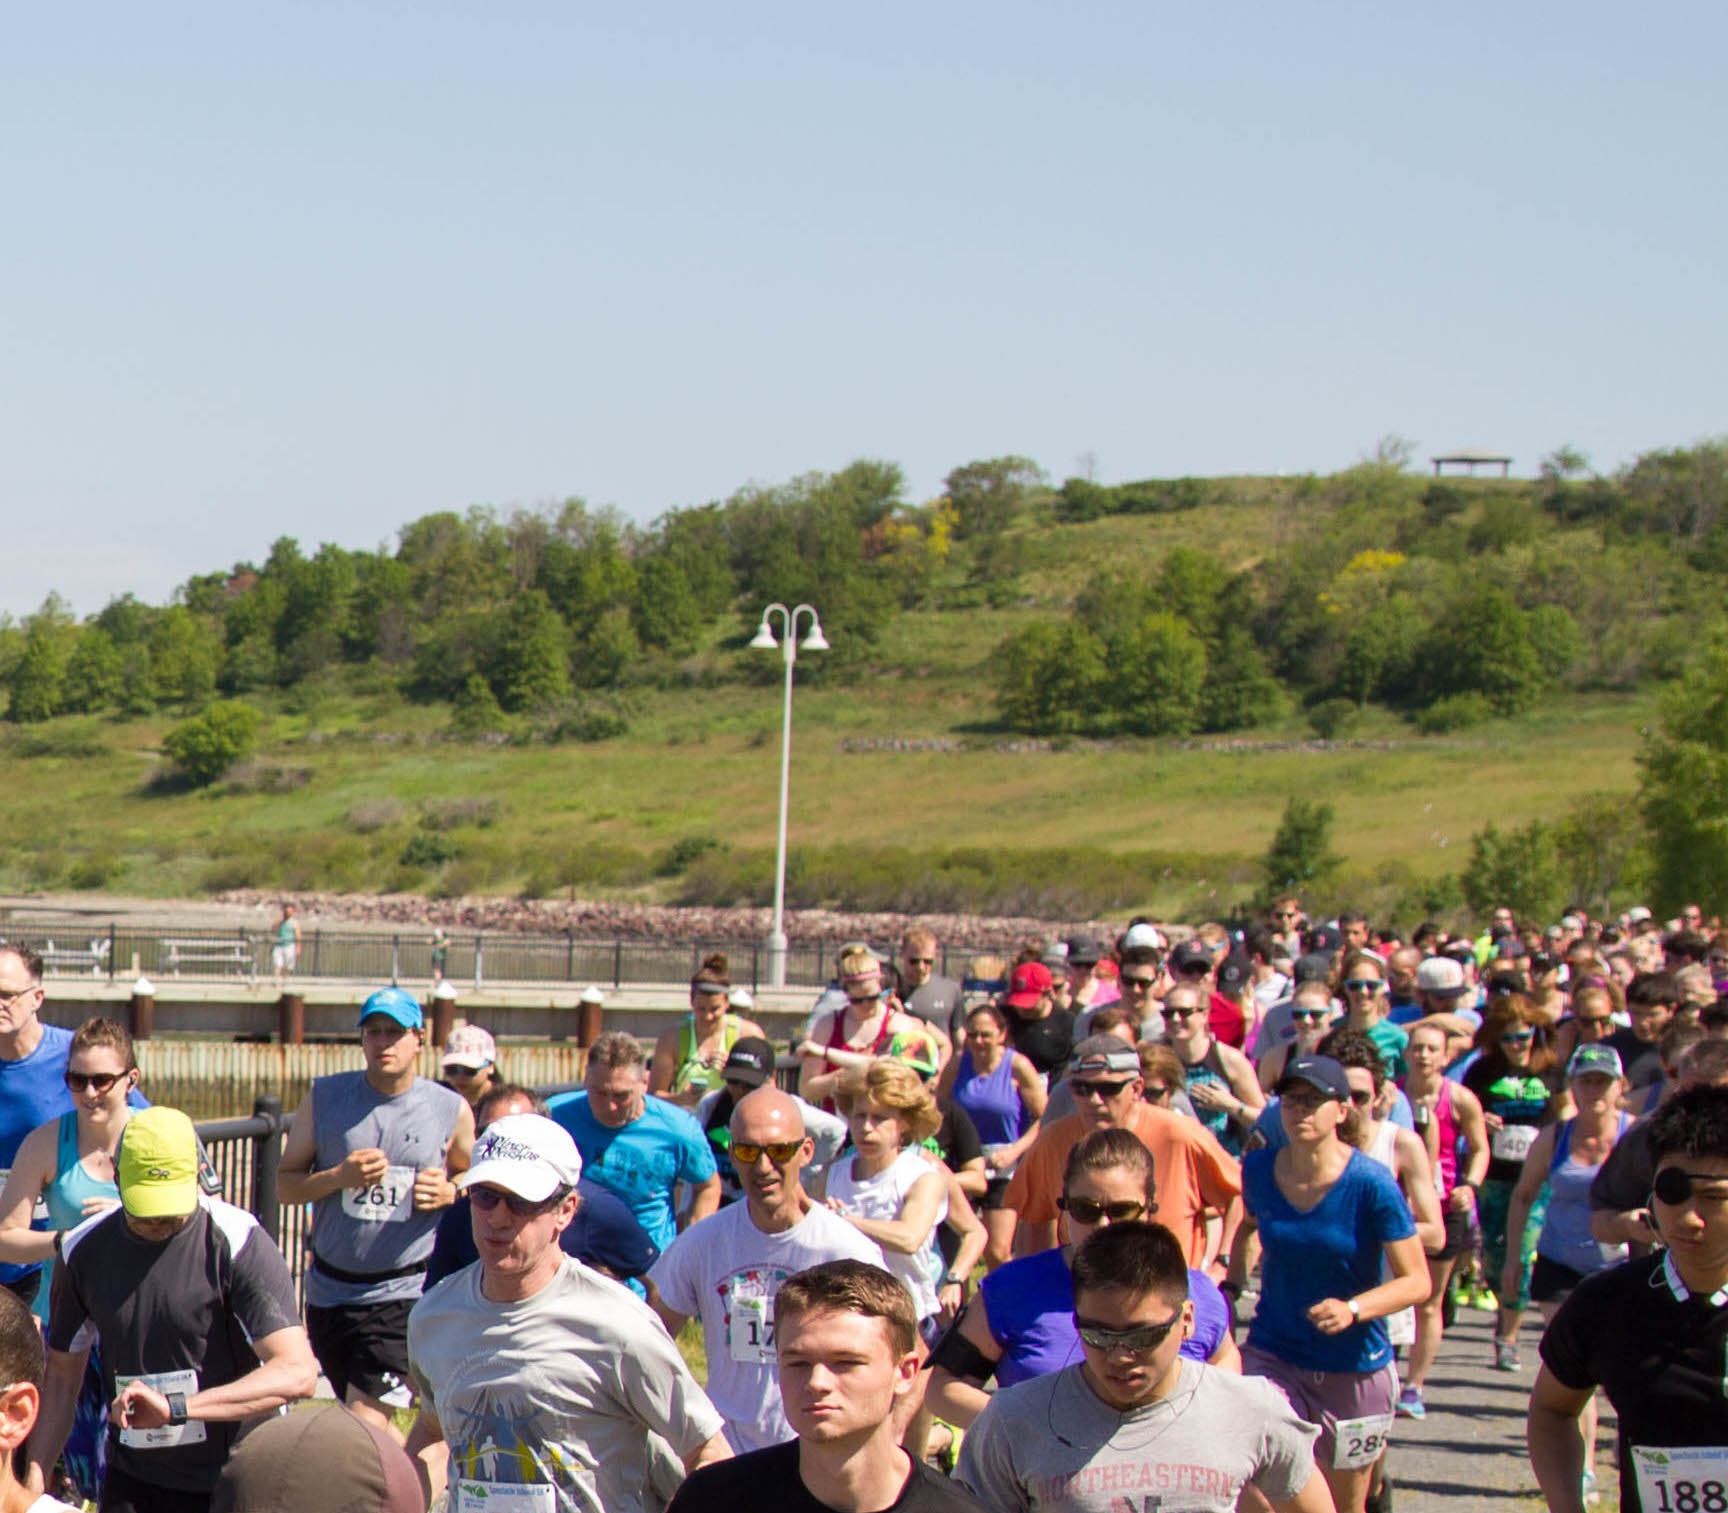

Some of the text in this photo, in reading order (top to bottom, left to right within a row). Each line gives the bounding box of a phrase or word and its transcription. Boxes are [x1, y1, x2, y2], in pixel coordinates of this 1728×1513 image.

[353, 1184, 399, 1207] 261
[1037, 1462, 1235, 1501] NORTHEASTERN
[1655, 1480, 1728, 1513] 188
